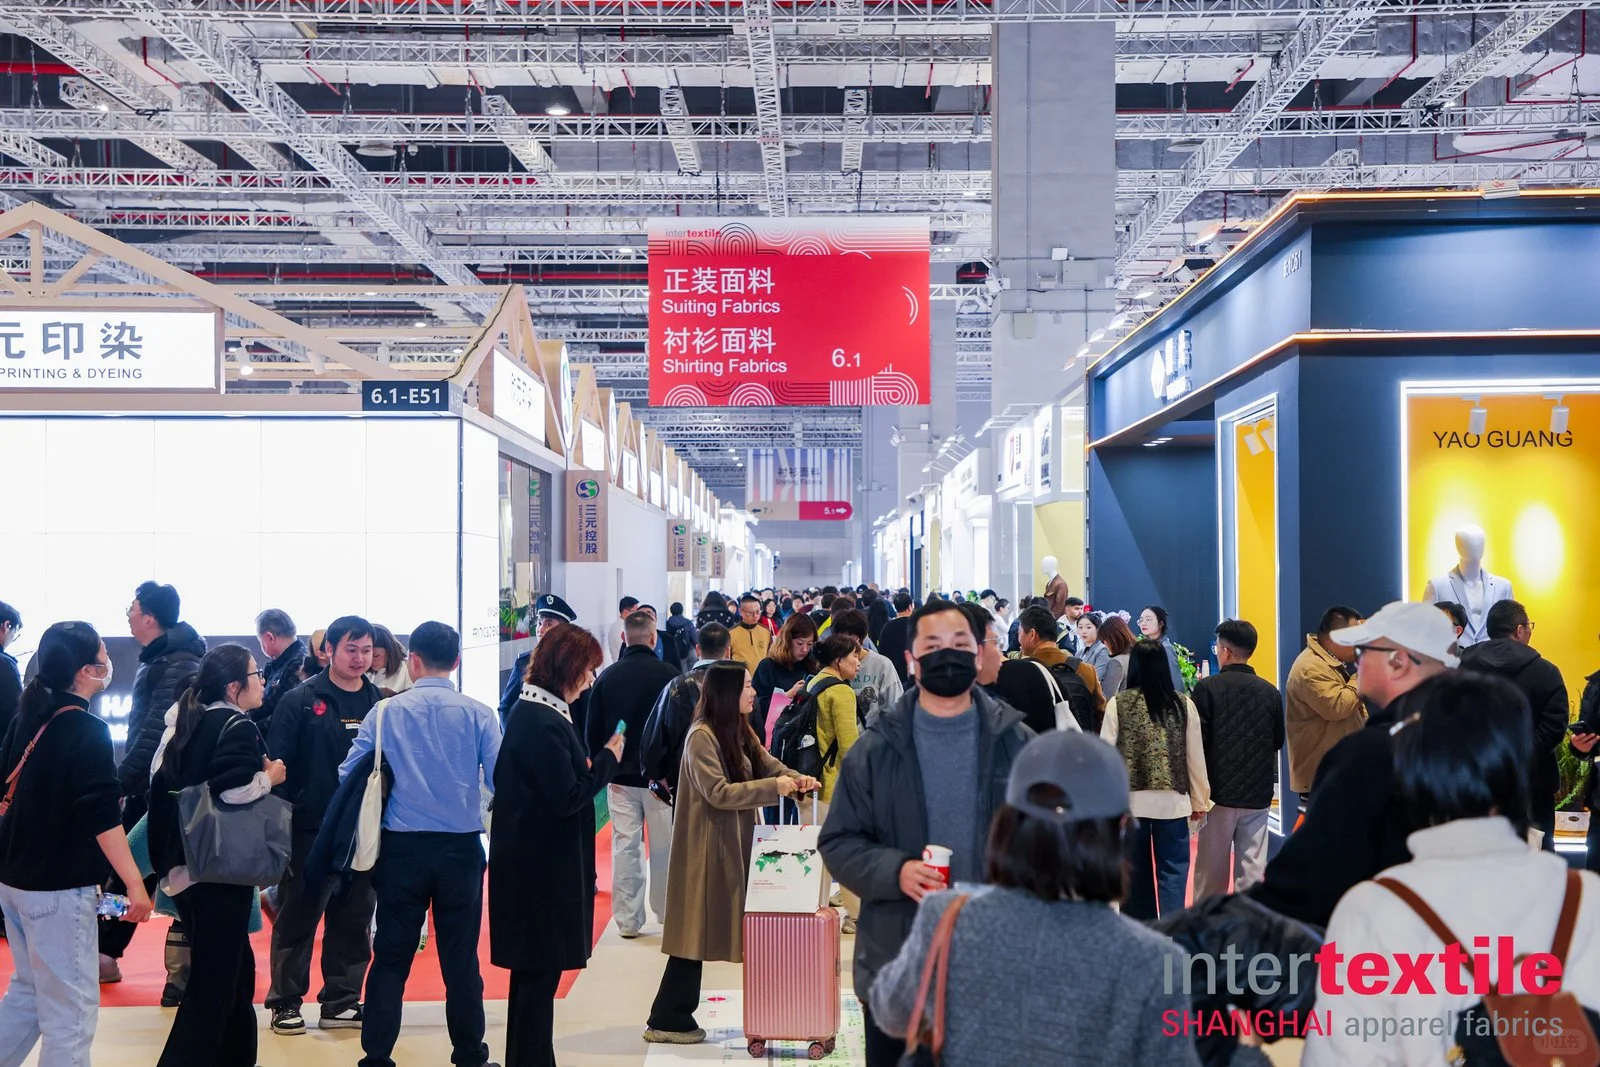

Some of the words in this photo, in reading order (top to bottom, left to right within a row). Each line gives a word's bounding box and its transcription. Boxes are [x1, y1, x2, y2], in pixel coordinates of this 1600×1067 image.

[665, 229, 721, 238] intertextile
[662, 266, 775, 294] 正装面料
[662, 299, 717, 316] Suiting
[722, 299, 781, 314] Fabrics
[0, 321, 143, 360] 元印染
[663, 327, 776, 354] 衬衫面料
[663, 358, 724, 376] Shirting
[729, 358, 788, 374] Fabrics
[831, 348, 861, 368] 6.1
[72, 368, 82, 379] &
[87, 368, 142, 379] DYEING
[371, 387, 440, 404] 6.1-E51
[1433, 431, 1481, 448] YAO
[1487, 430, 1573, 448] GUANG
[585, 504, 597, 554] 三元控股
